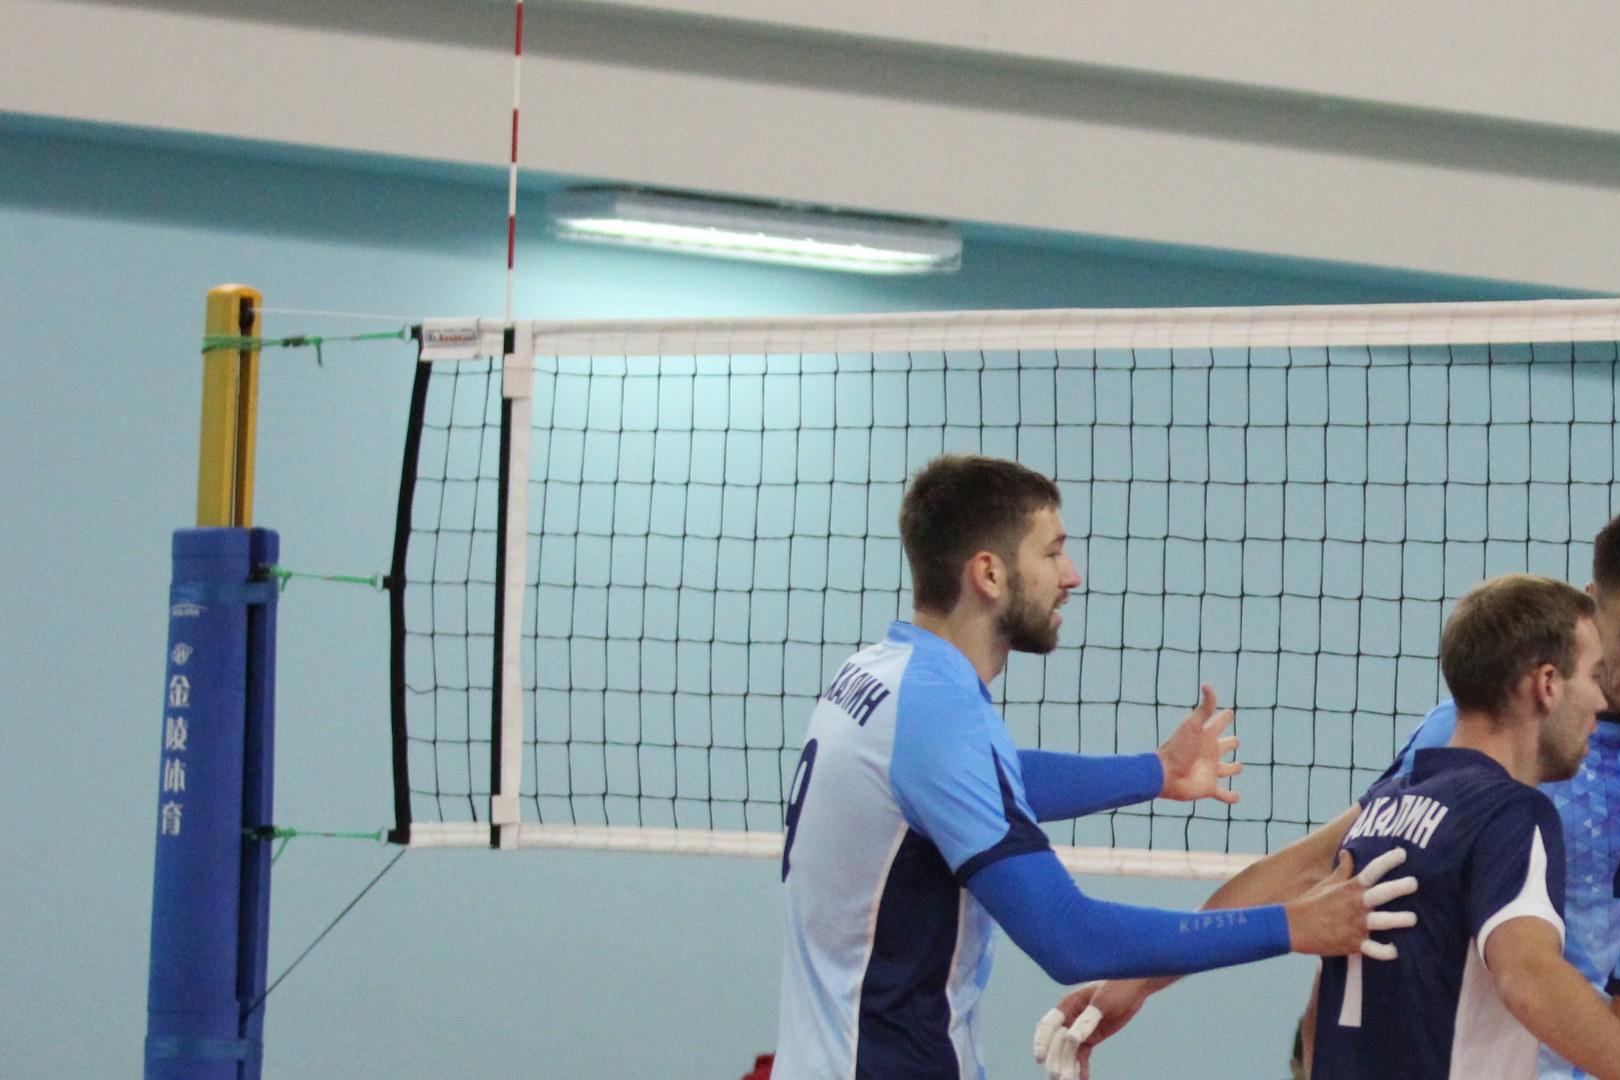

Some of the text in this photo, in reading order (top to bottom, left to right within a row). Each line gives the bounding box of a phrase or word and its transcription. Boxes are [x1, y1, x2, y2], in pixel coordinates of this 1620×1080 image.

[161, 674, 191, 836] 金陵体育
[1342, 794, 1449, 849] АХАЛИН
[1179, 911, 1248, 934] KIPSTA
